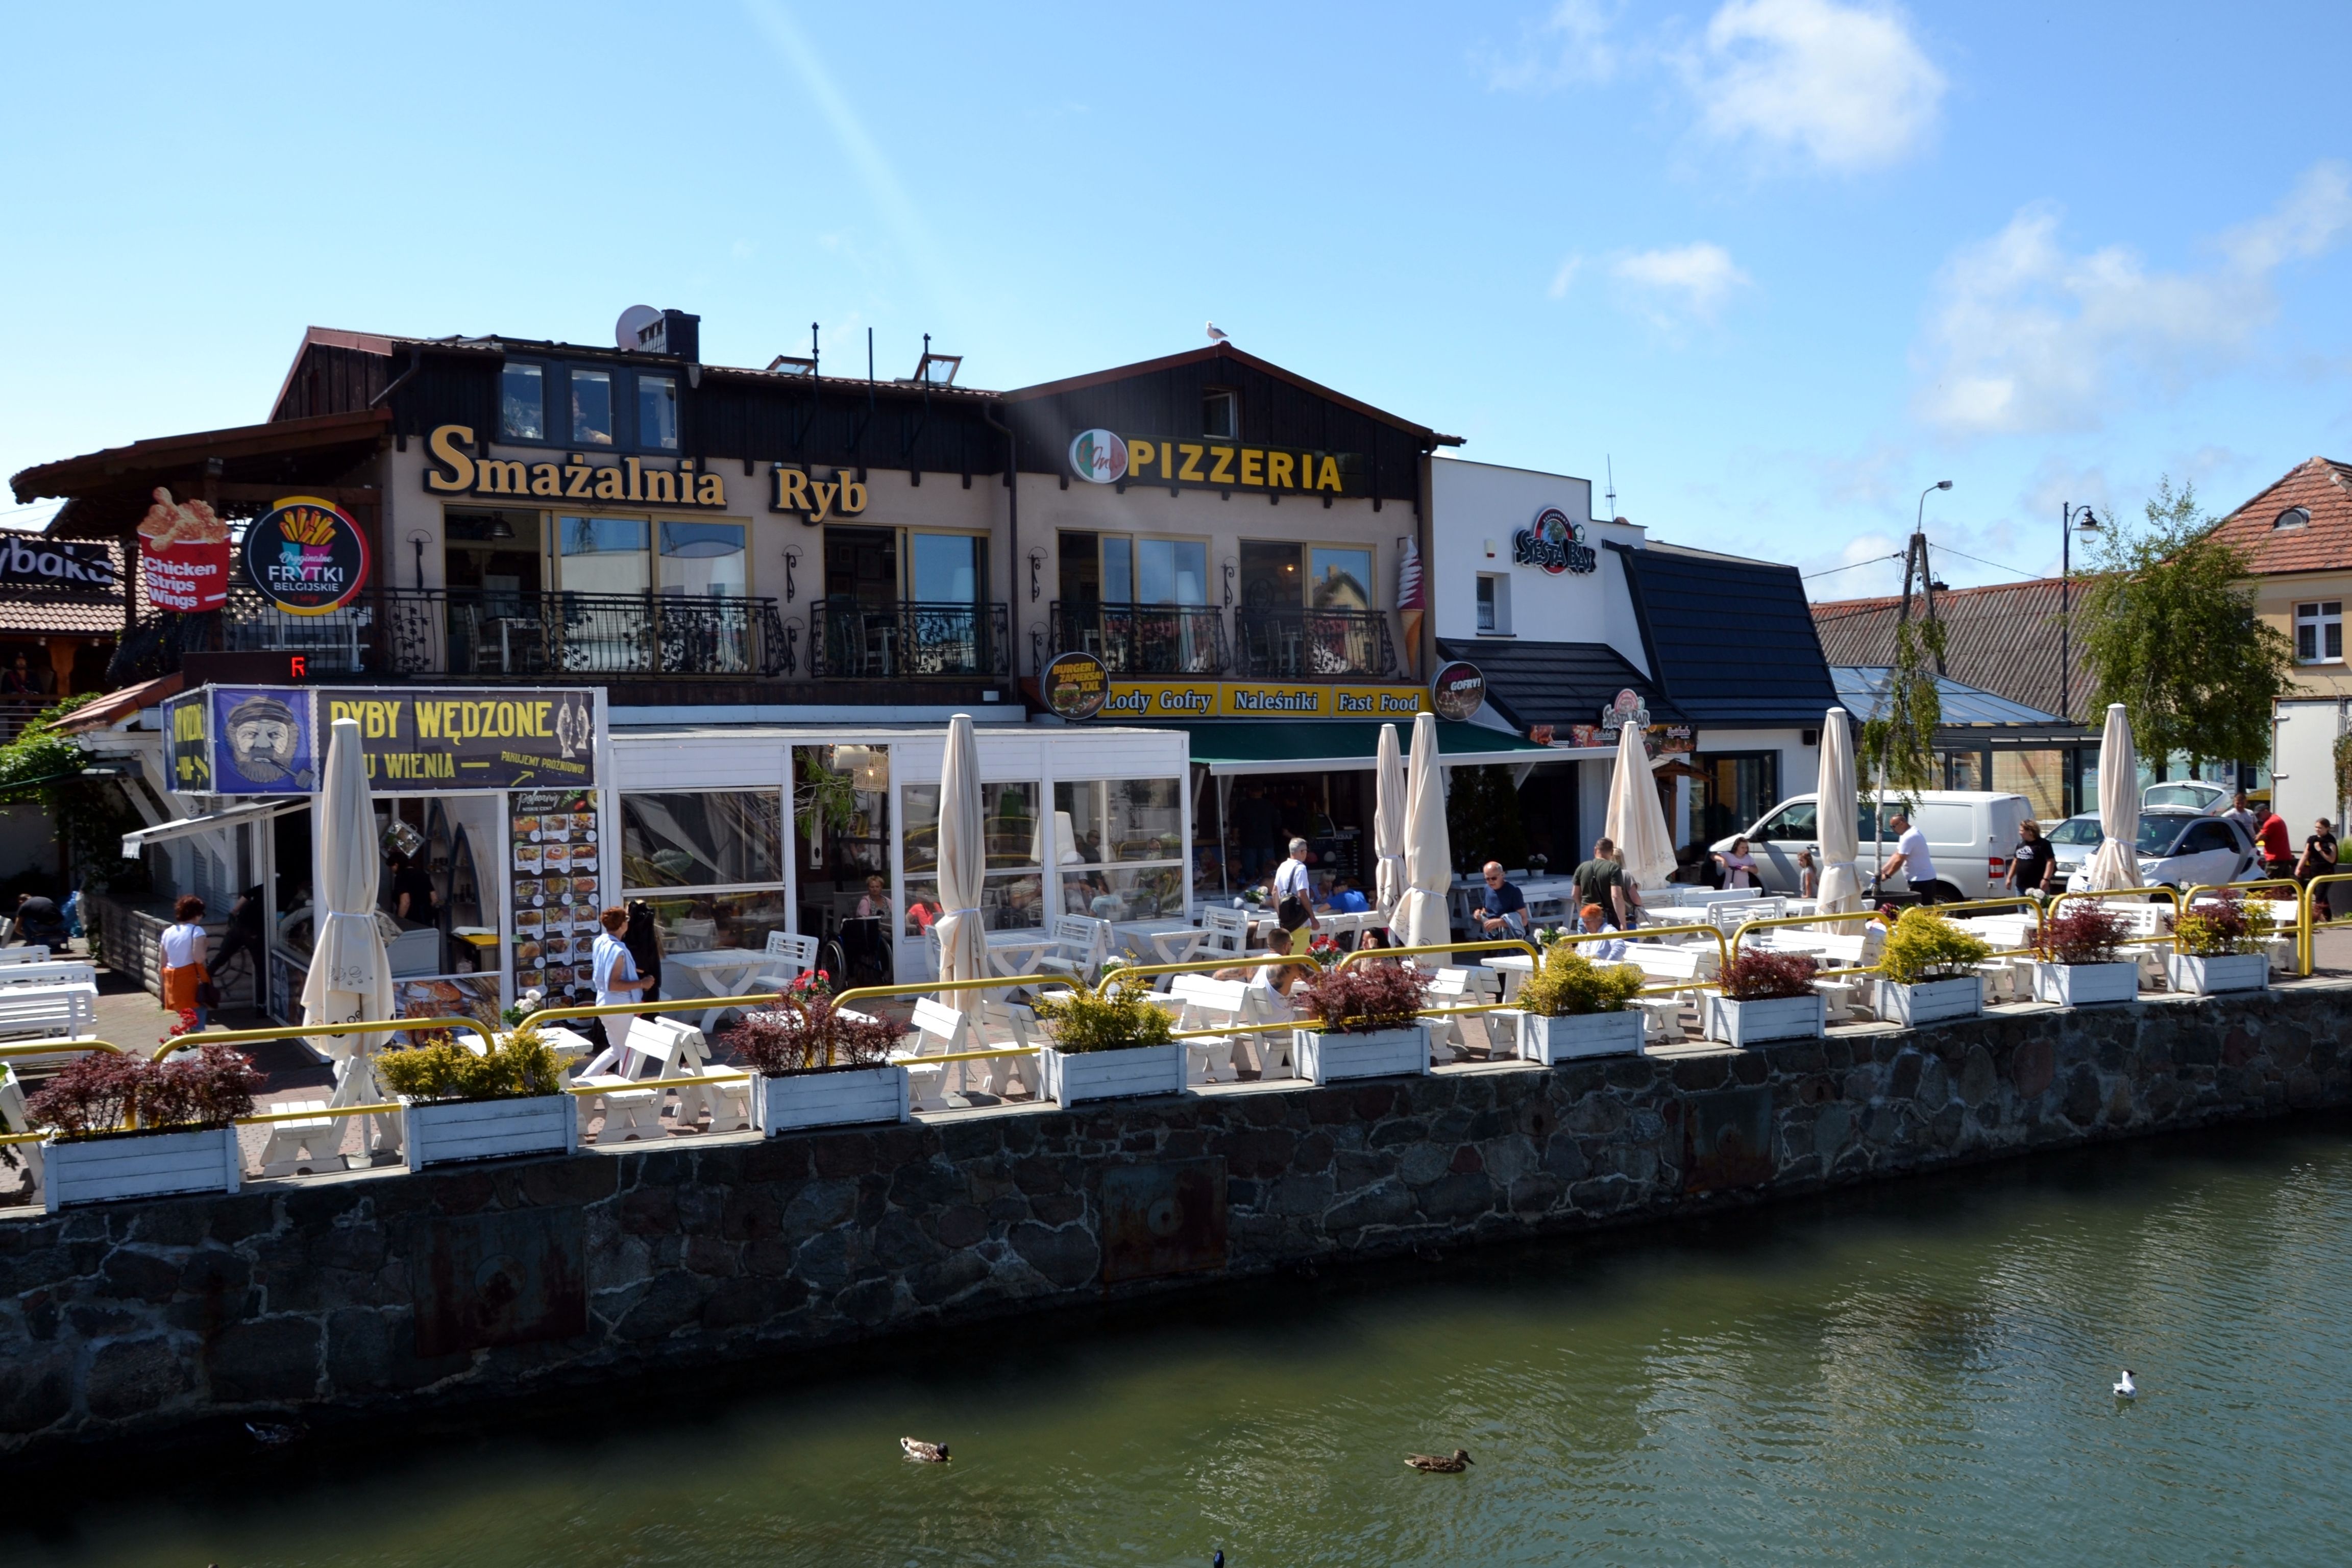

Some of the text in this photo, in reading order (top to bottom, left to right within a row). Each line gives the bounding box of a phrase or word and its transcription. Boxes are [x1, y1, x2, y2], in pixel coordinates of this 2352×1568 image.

[430, 424, 868, 523] Smażalnia Ryb
[1128, 439, 1343, 492] PIZZERIA
[143, 556, 217, 576] Chicken
[279, 551, 333, 566] Oryginalne
[1567, 539, 1597, 574] BAR
[146, 572, 196, 594] Strips
[268, 565, 344, 582] FRYTKI
[274, 582, 339, 592] BELGIJSKIE
[148, 587, 198, 610] Wings
[1053, 663, 1096, 675] BURGER!
[1059, 671, 1105, 683] ZAPIEKSA!
[1081, 681, 1100, 692] XXL
[1450, 677, 1481, 691] GOFRY!
[1105, 691, 1211, 714] Lody Gofry
[1235, 691, 1318, 710] Naleśniki
[1338, 693, 1419, 710] Fast Food
[414, 701, 553, 746] WĘDZONE
[384, 753, 456, 778] WIENIA
[501, 751, 540, 767] PAKUJEMY
